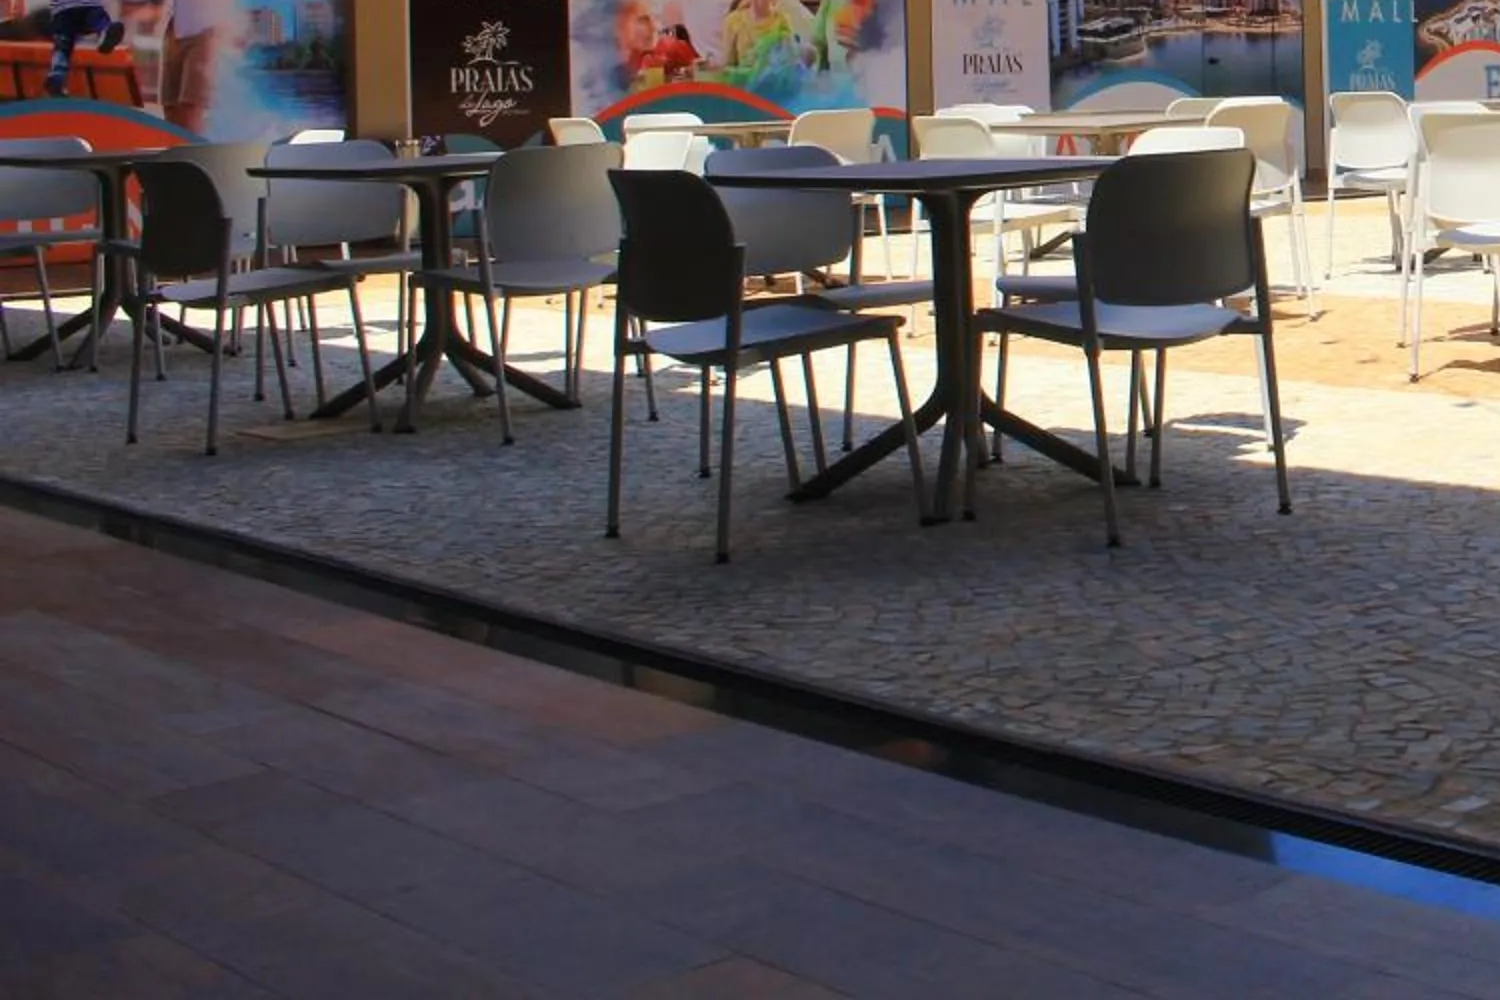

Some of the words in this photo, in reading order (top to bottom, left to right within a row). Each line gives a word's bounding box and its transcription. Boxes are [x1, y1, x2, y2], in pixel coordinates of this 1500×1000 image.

[1341, 0, 1419, 23] MALL
[963, 53, 1024, 74] PRAIAS
[450, 66, 534, 93] PRAIAS
